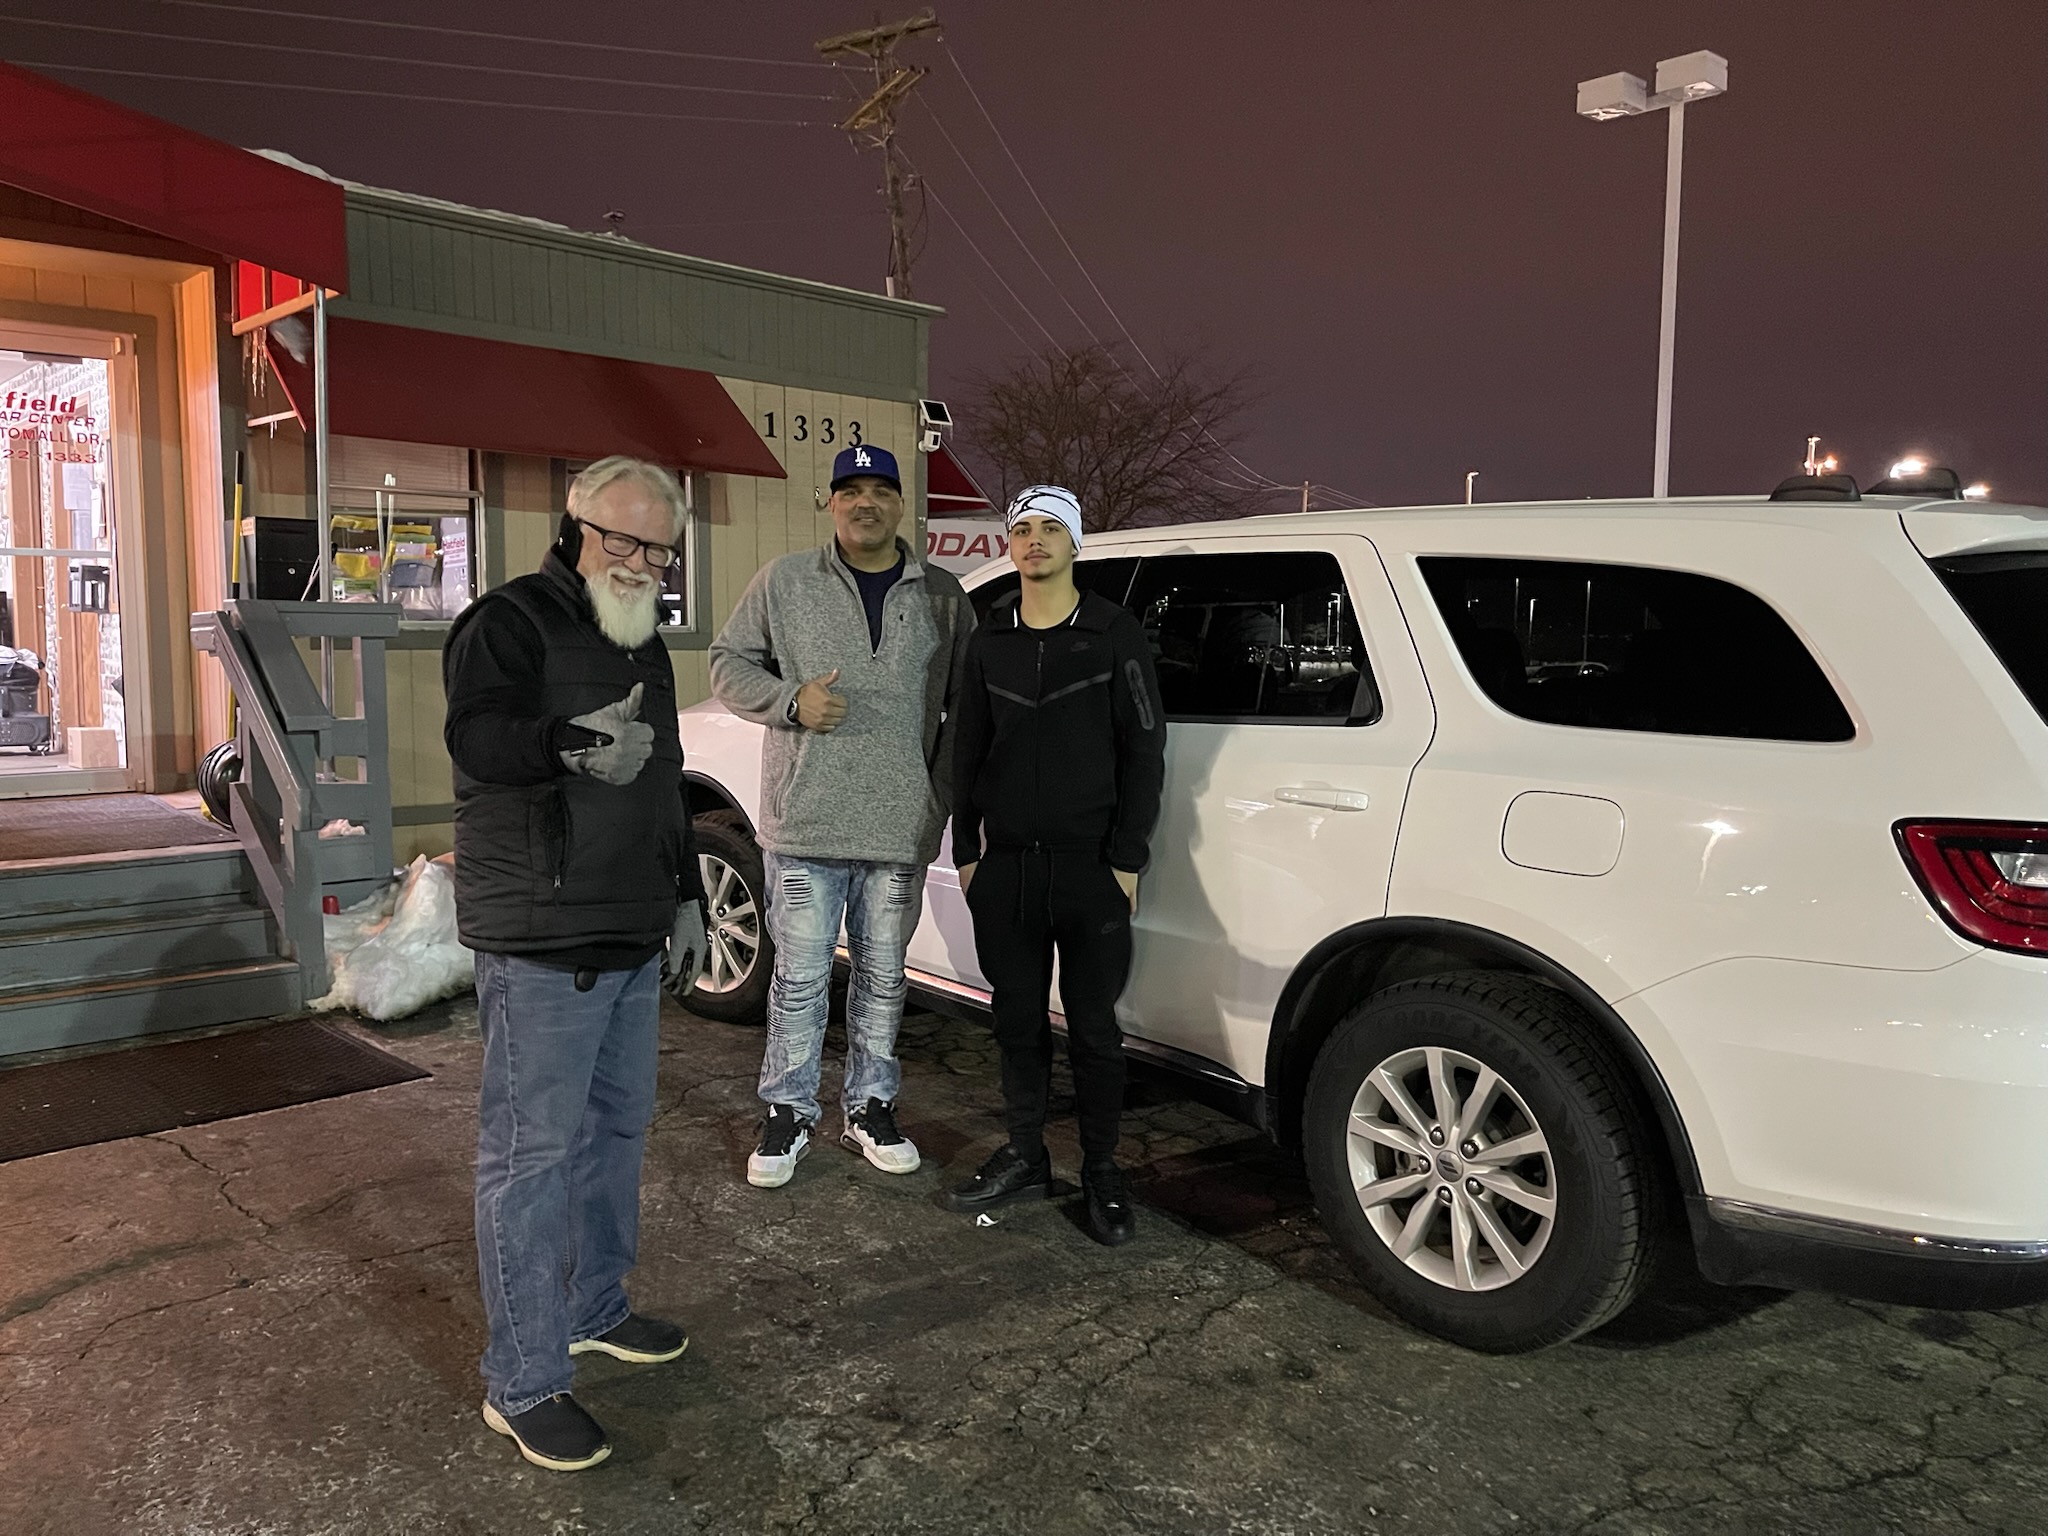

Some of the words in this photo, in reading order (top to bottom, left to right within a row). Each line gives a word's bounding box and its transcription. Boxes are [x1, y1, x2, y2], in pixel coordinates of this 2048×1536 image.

[0, 391, 77, 413] field
[28, 413, 96, 428] CENTER
[764, 412, 862, 447] 1333
[77, 432, 100, 445] DR
[854, 447, 872, 467] LA
